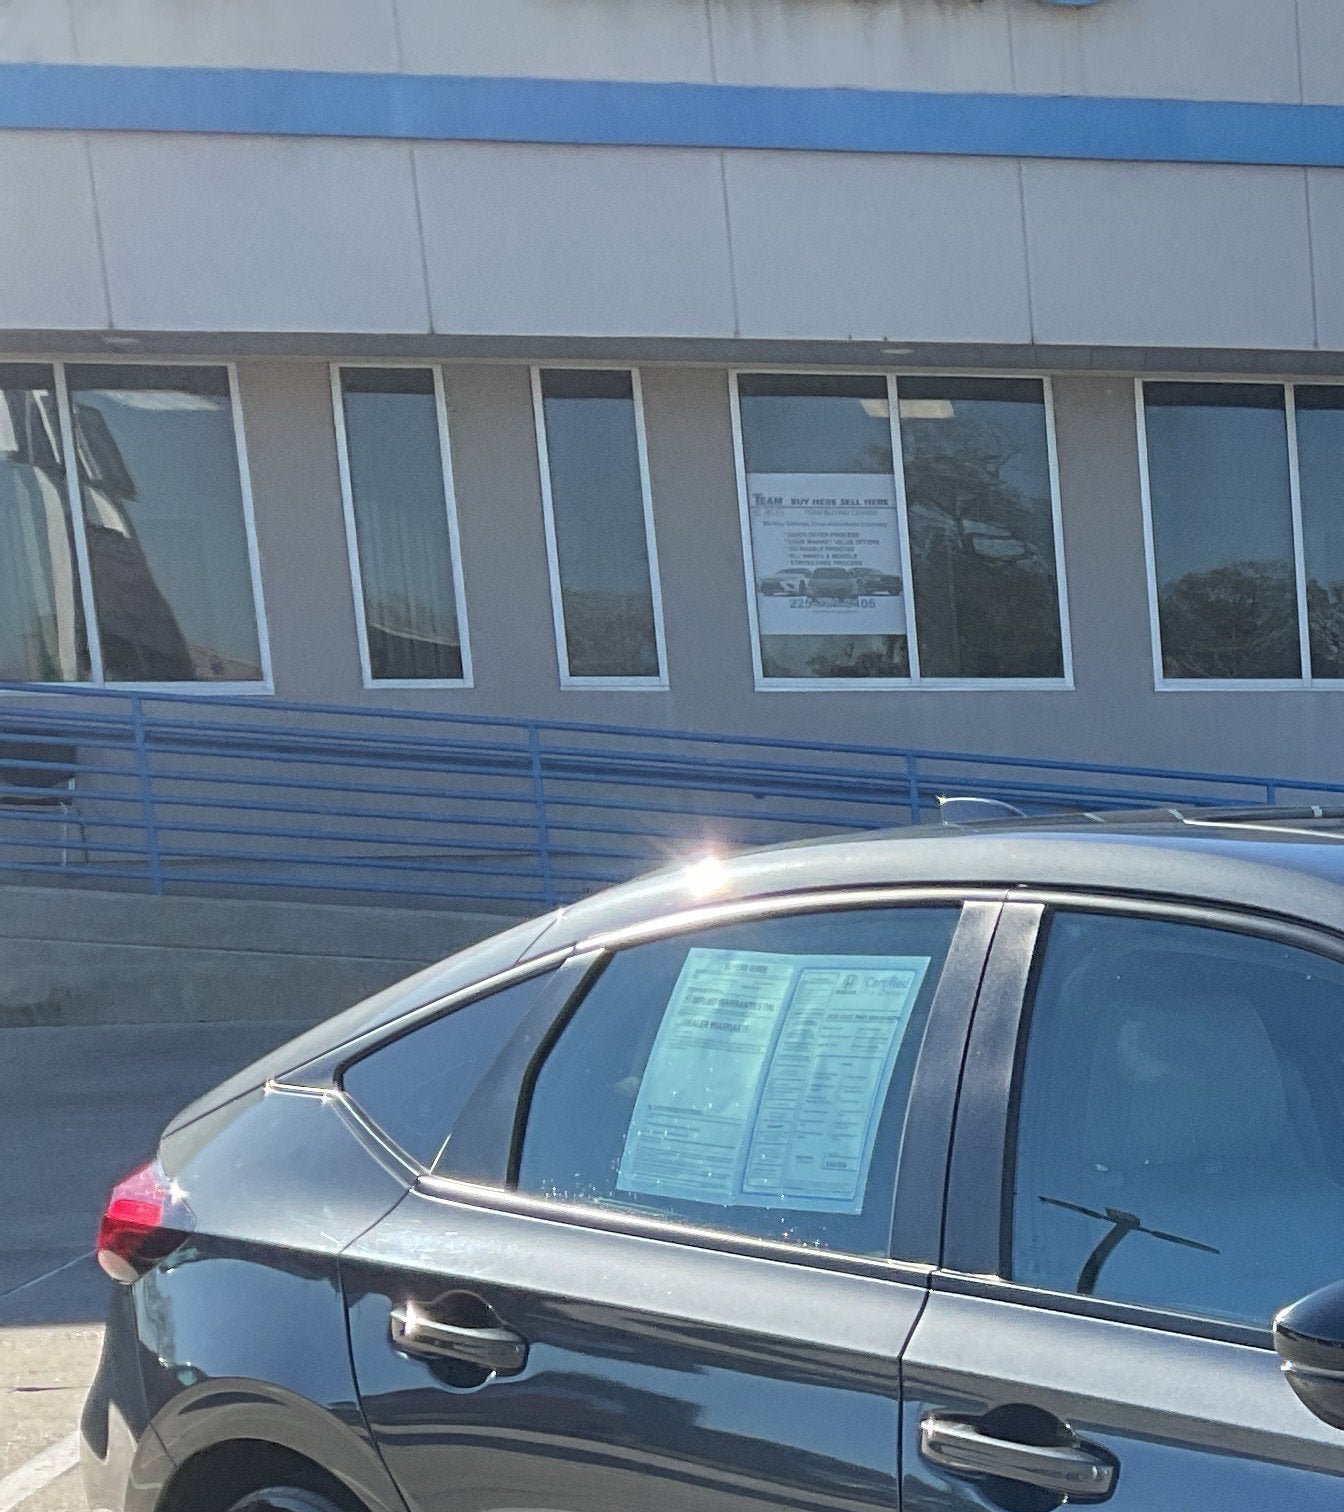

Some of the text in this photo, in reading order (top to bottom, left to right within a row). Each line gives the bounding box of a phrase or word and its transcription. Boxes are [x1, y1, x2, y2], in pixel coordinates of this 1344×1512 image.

[790, 498, 889, 506] BUY HERE SELL HERE
